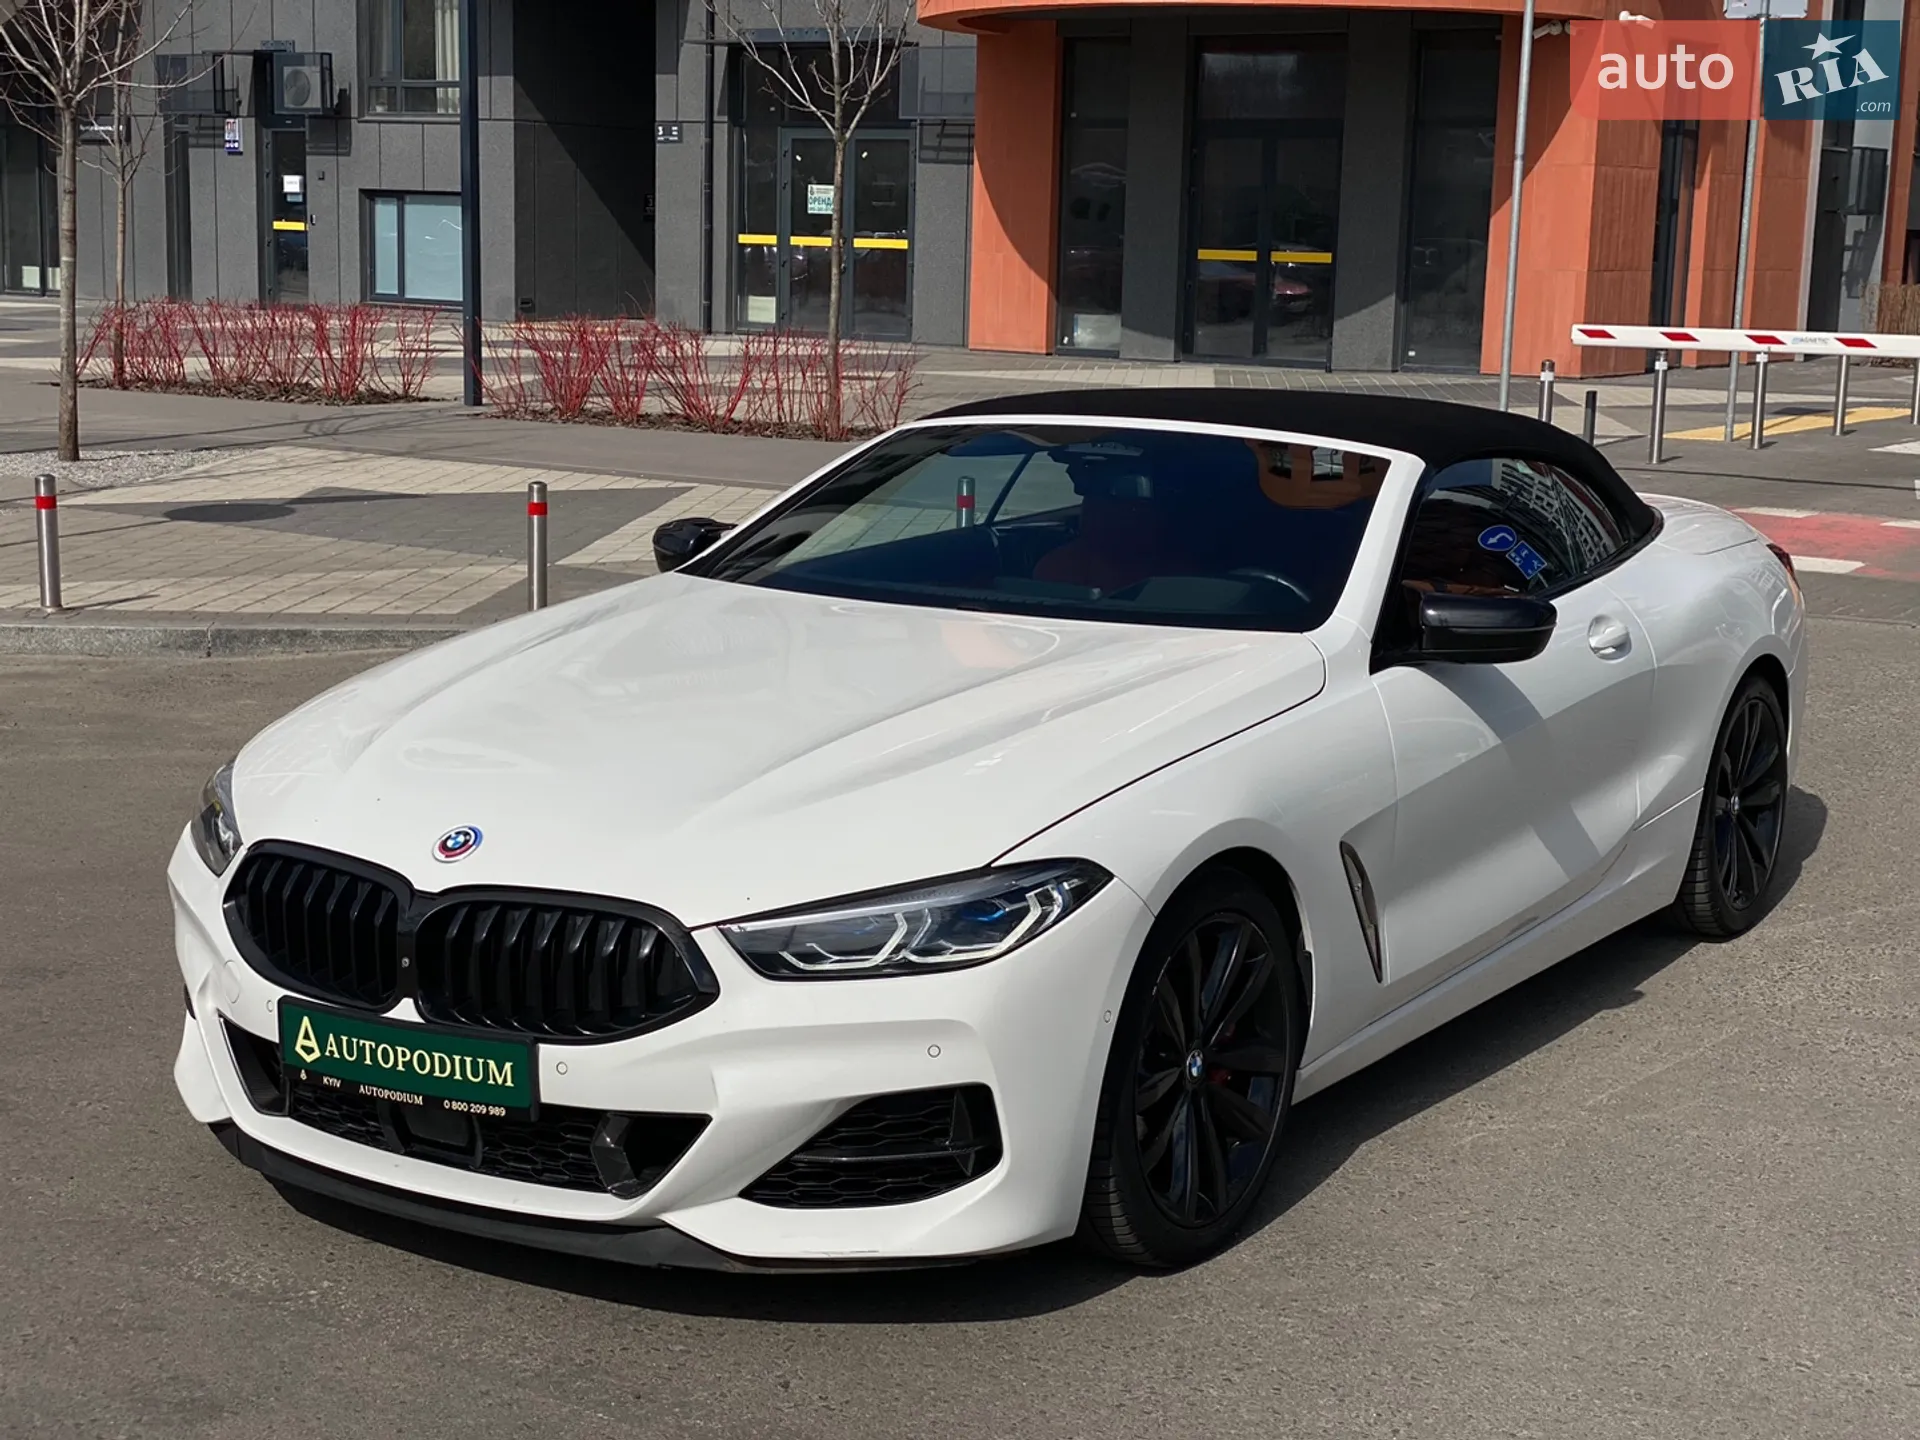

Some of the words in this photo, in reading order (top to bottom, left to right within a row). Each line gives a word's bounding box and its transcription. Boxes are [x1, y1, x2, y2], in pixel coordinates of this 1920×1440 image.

[809, 196, 833, 207] ОРЕНД
[324, 1033, 515, 1087] AUTOPODIUM
[322, 1076, 342, 1089] KYIV
[358, 1084, 423, 1106] AUTOPODIUM
[443, 1099, 451, 1109] 0
[451, 1101, 468, 1113] 800
[469, 1102, 487, 1115] 209
[488, 1105, 506, 1117] 989
